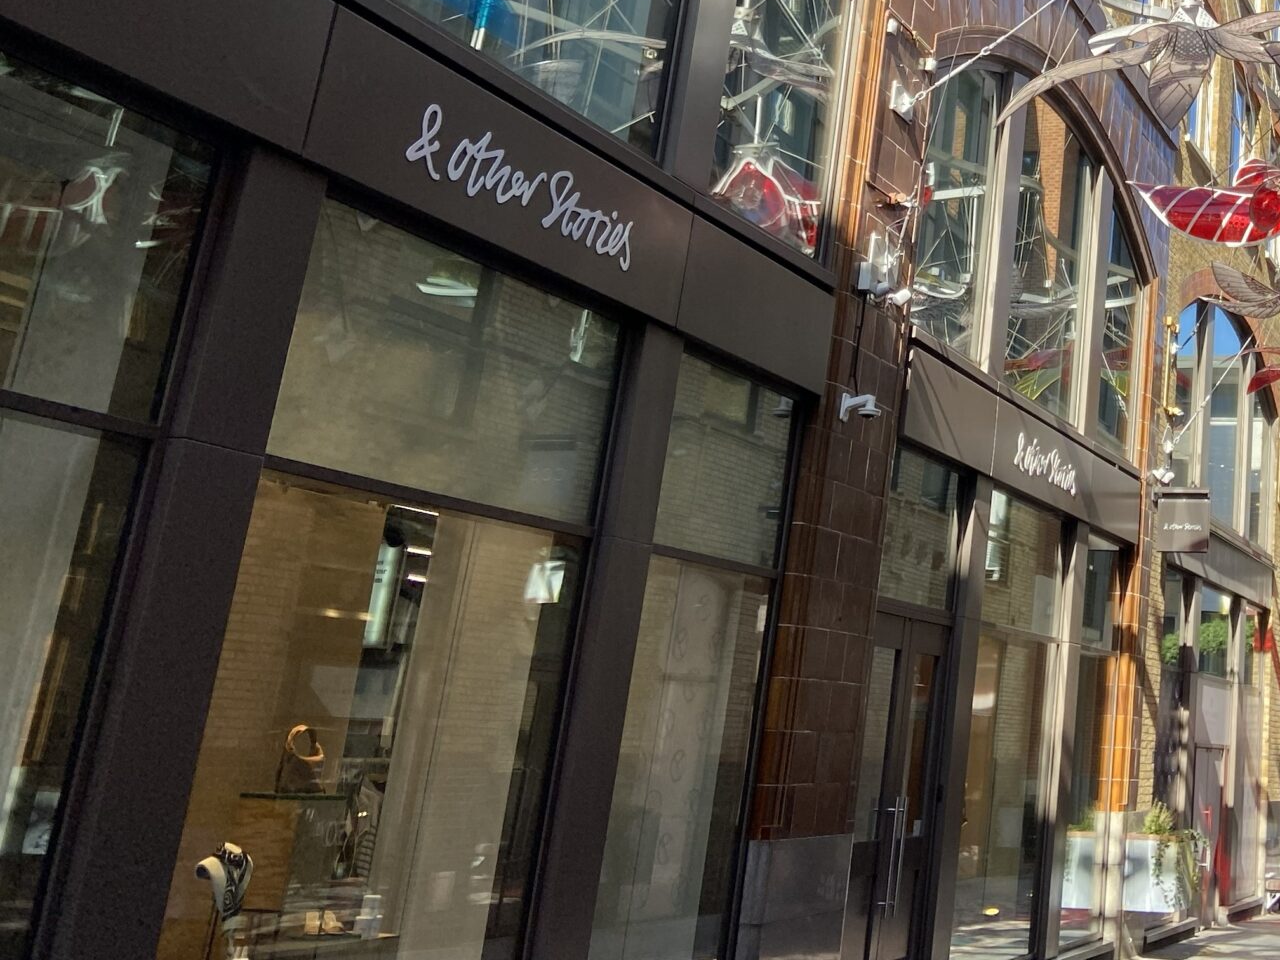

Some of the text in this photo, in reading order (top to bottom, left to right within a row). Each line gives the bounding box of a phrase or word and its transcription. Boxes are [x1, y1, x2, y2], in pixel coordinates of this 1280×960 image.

[405, 103, 634, 272] & other Stories
